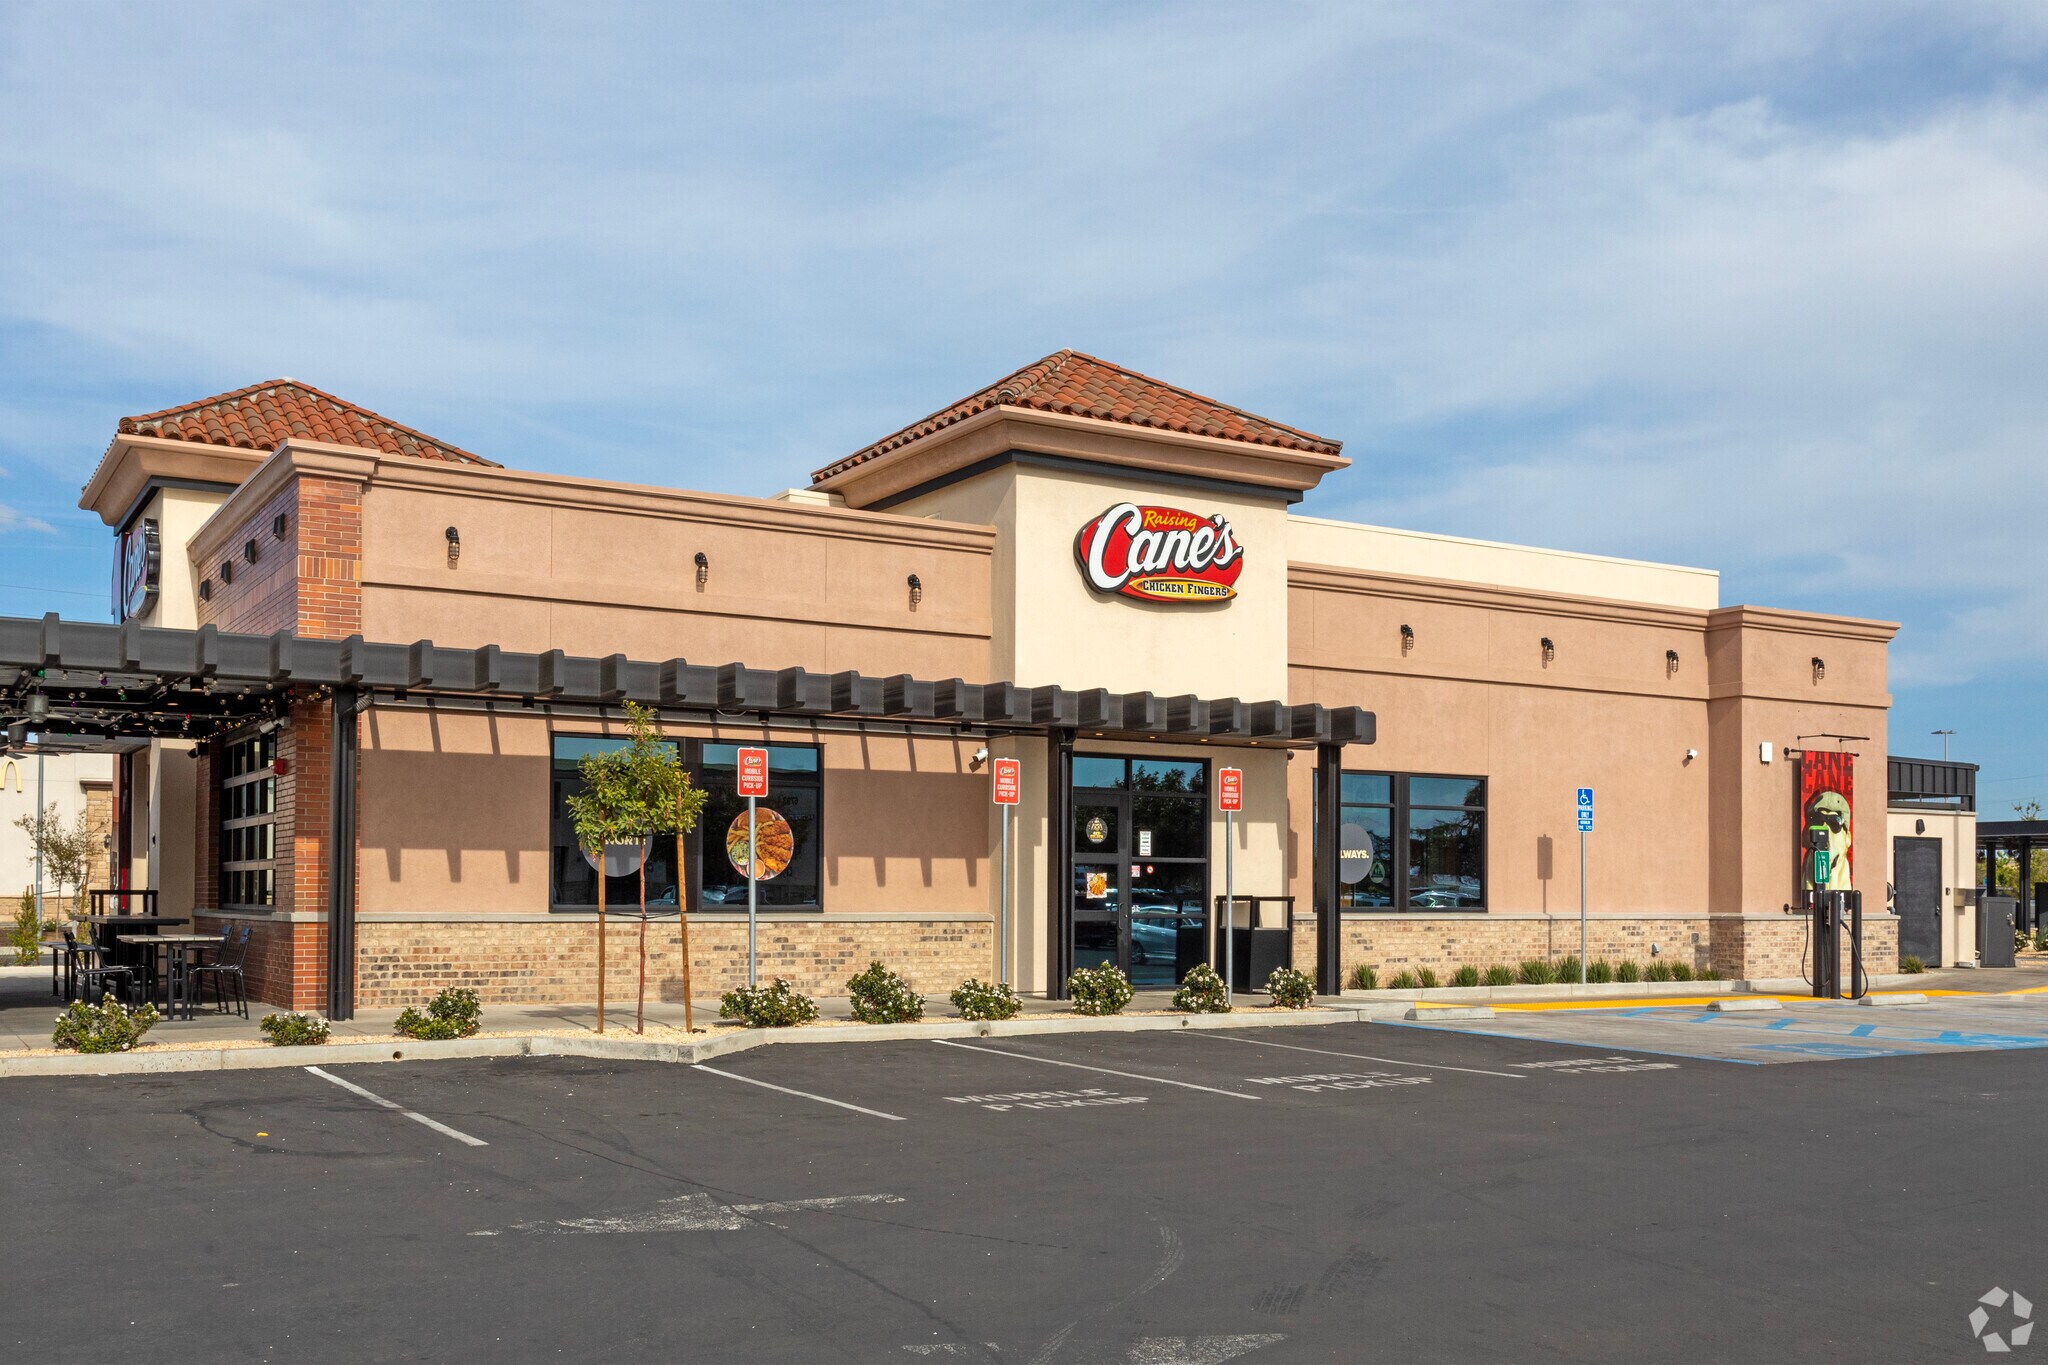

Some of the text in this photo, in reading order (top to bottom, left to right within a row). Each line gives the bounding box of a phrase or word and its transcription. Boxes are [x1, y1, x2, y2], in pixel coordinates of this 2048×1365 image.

[1143, 510, 1198, 532] Raising
[1088, 503, 1244, 590] Cane's
[1142, 580, 1228, 597] CHICKEN FINGERS
[1340, 849, 1369, 859] LWAYS.
[941, 1088, 1120, 1103] MOBILE
[980, 1096, 1150, 1112] PICKUP
